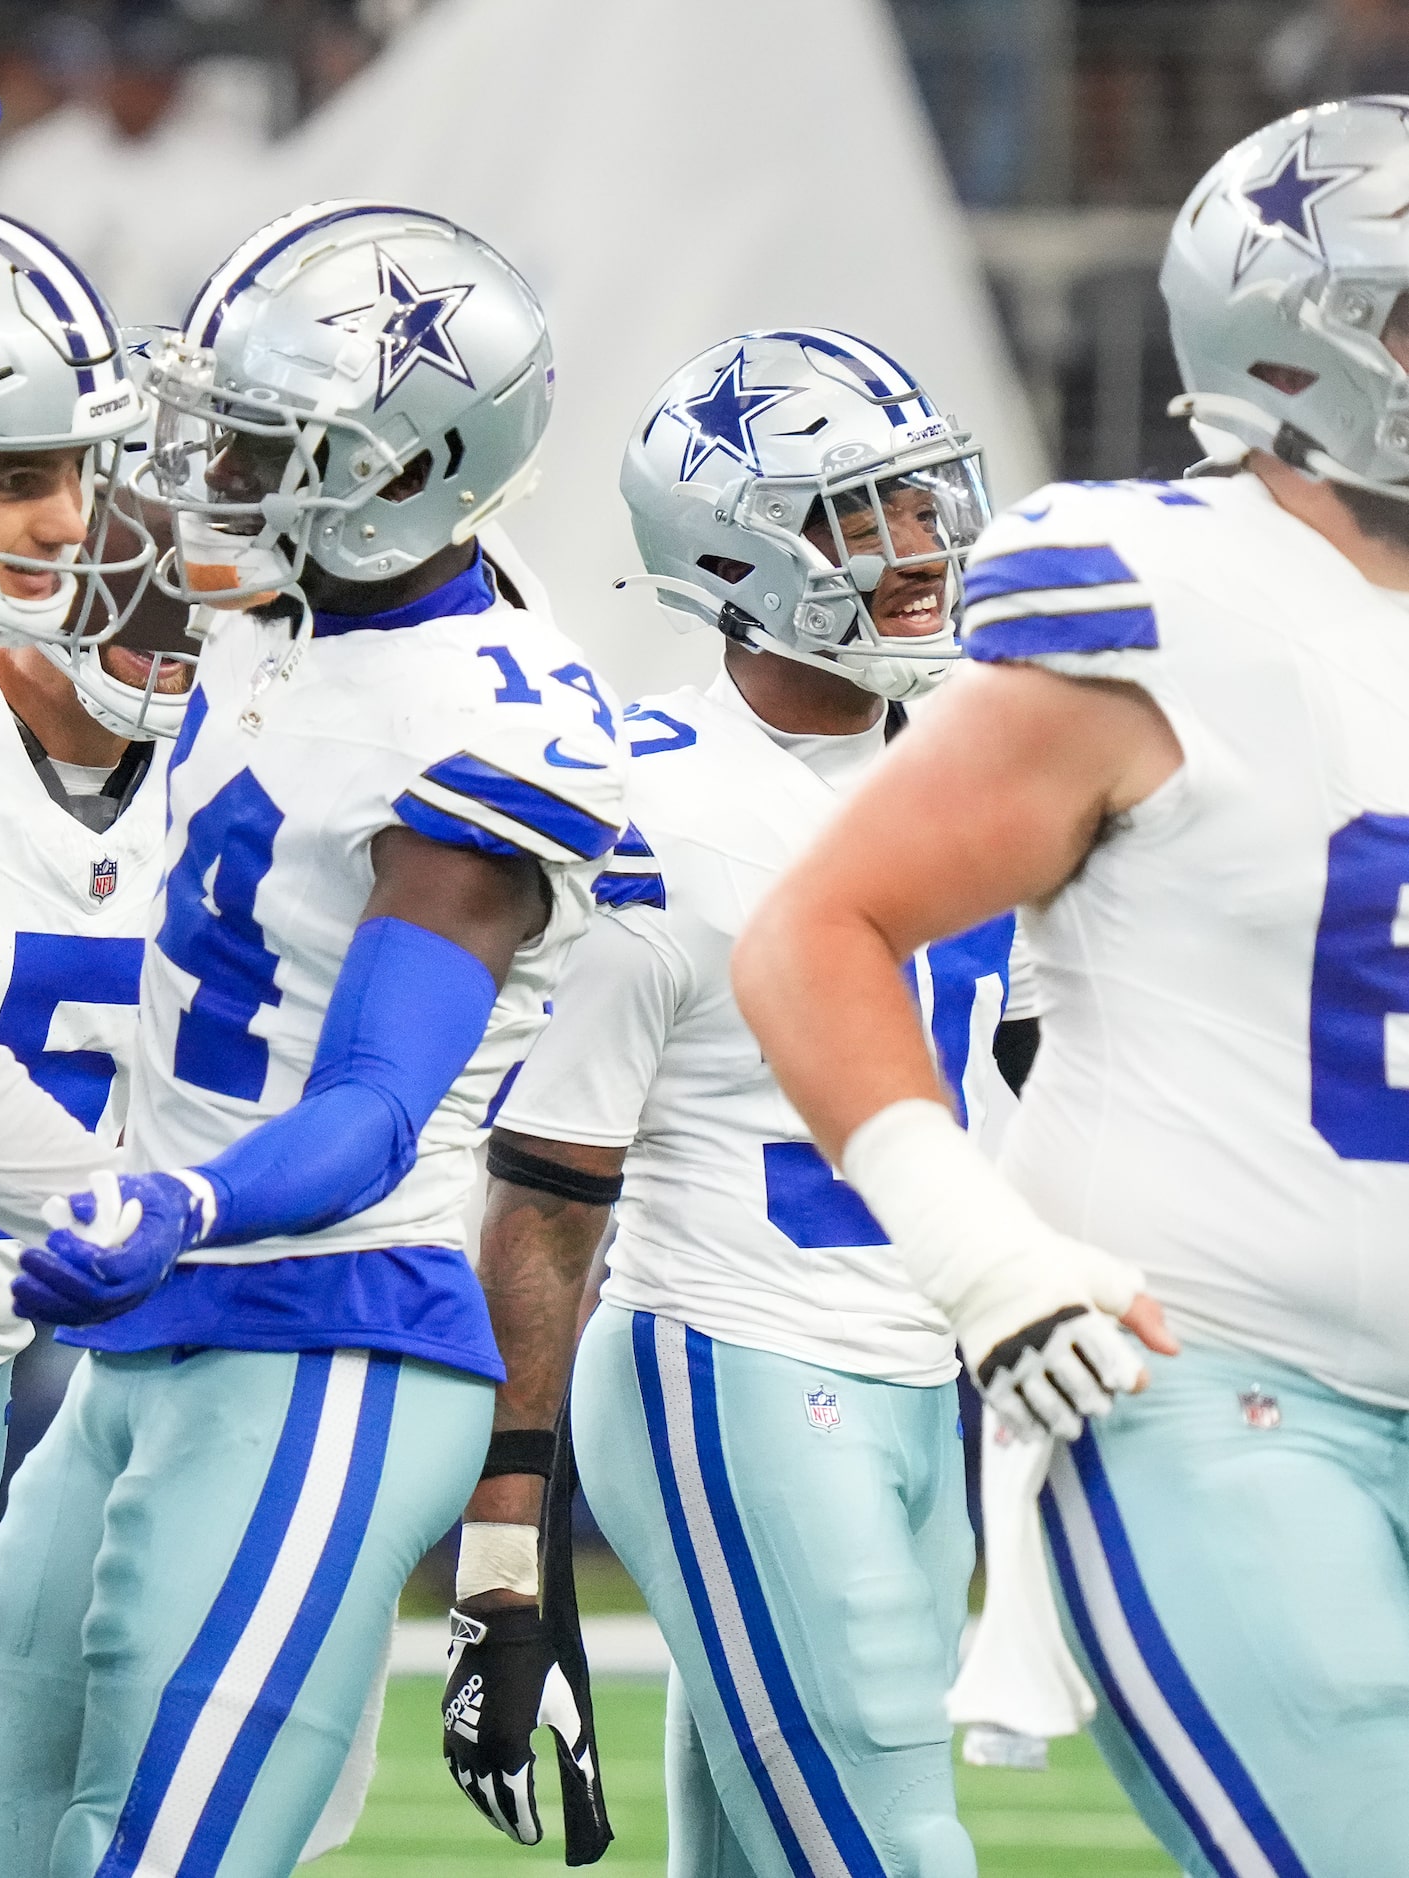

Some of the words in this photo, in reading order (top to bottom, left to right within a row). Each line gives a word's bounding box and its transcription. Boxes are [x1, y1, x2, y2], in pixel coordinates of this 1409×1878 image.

[476, 645, 616, 744] 14
[93, 876, 113, 895] NFL
[812, 1407, 838, 1423] NFL
[444, 1674, 483, 1731] adidas
